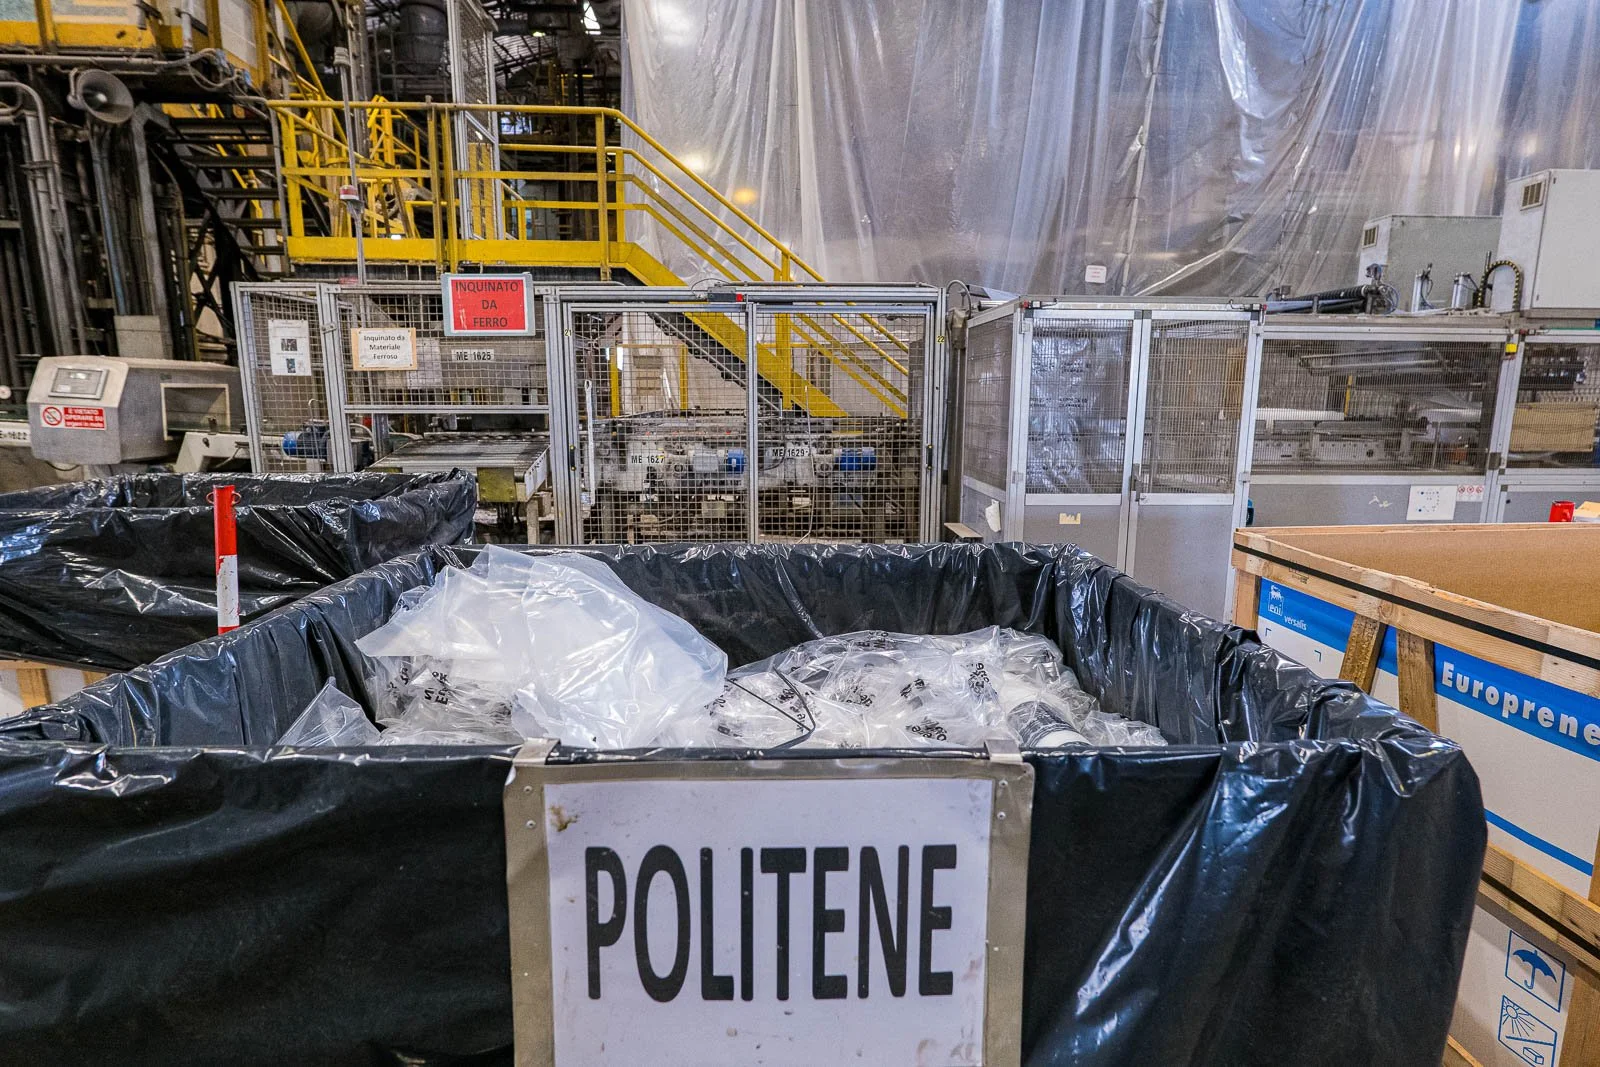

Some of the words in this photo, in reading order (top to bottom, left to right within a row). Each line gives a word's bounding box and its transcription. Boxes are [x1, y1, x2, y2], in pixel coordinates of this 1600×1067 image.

[456, 282, 518, 293] INQUINATO
[482, 300, 497, 310] DA
[473, 317, 508, 327] FERRO
[456, 351, 469, 361] ME
[631, 455, 642, 464] ME
[1269, 604, 1282, 616] eni
[1284, 615, 1307, 631] versalis
[1441, 661, 1600, 745] Europrene
[585, 844, 957, 1003] POLITENE
